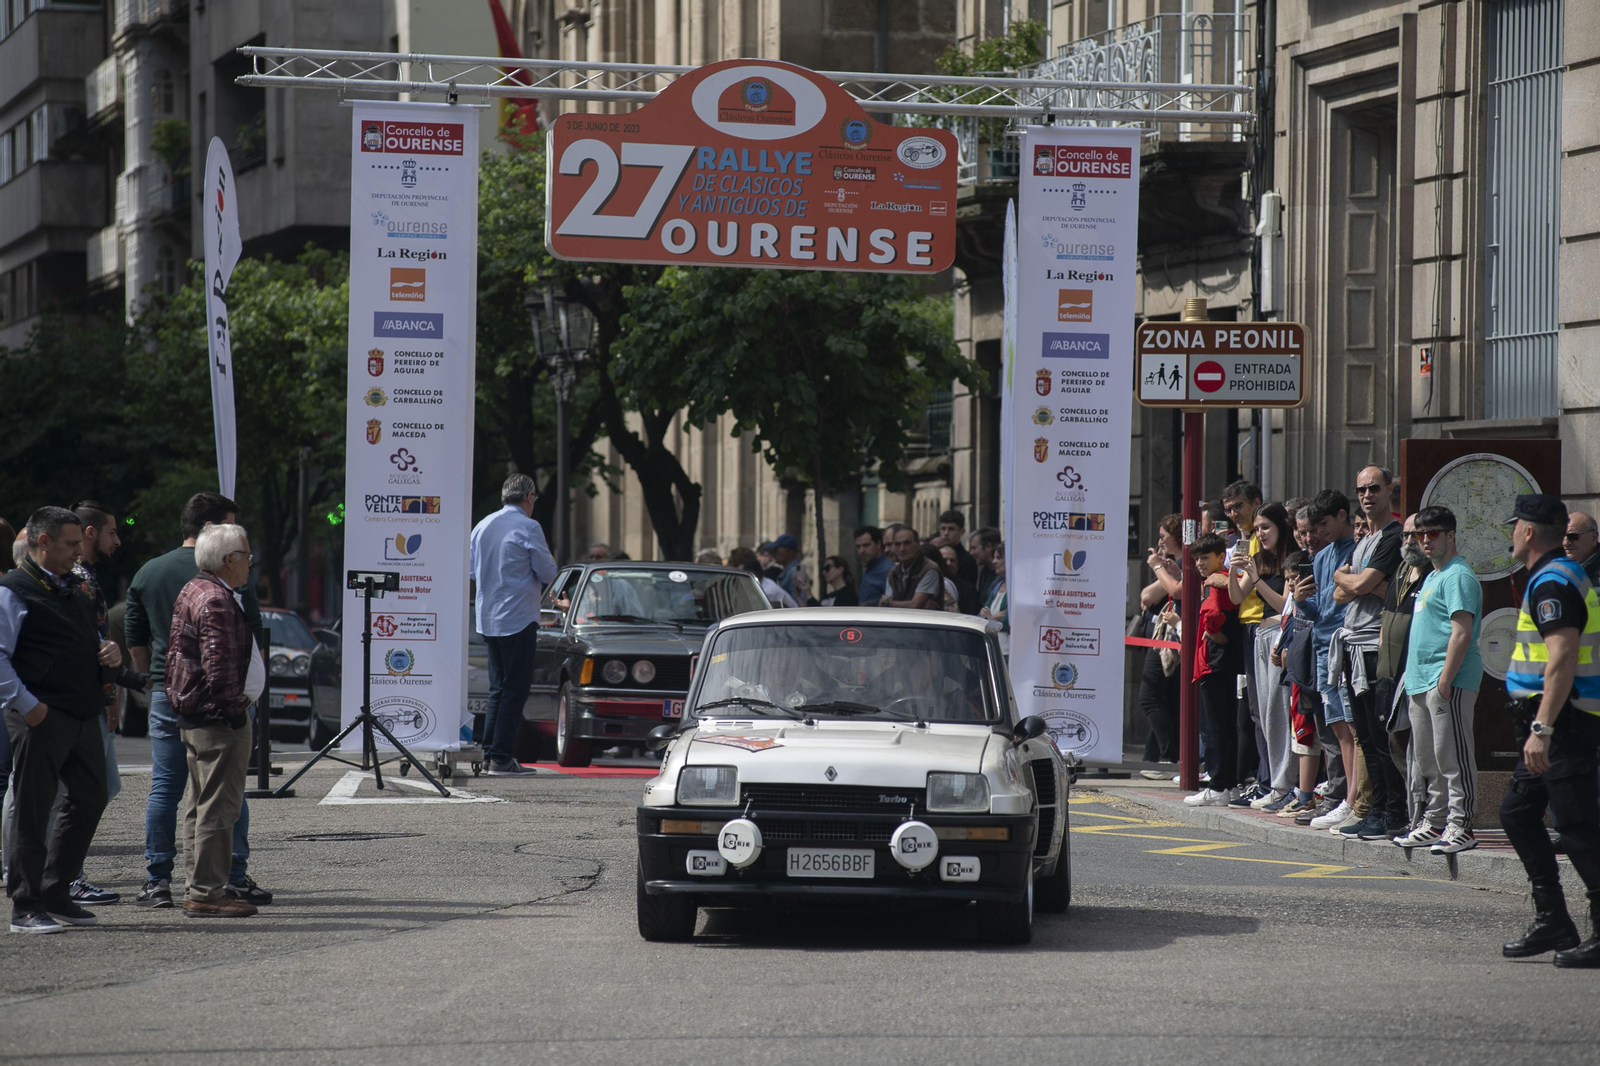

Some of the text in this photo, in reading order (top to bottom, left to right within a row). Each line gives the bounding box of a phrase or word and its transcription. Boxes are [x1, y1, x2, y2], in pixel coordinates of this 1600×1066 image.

[719, 112, 793, 124] Clásicos Ourense
[386, 124, 450, 137] Concello de
[566, 120, 641, 133] 3 DE JUNIO DE 2023
[385, 137, 462, 151] OURENSE
[818, 150, 892, 162] Clásicos Ourense
[1058, 149, 1119, 160] Concello de
[697, 146, 813, 175] RALLYE
[1057, 161, 1130, 175] OURENSE
[843, 173, 876, 181] OURENSE
[555, 138, 695, 240] 27
[692, 173, 803, 196] DE CLASICOS
[371, 192, 410, 200] DEPUTACIÓN
[678, 193, 808, 218] Y ANTIGUOS DE
[870, 201, 922, 213] La Región
[387, 220, 448, 234] ourense
[660, 218, 933, 266] OURENSE
[1056, 243, 1115, 255] ourense
[377, 247, 447, 262] La Región
[1046, 269, 1114, 283] La Región
[391, 291, 424, 299] telemiño
[1060, 312, 1091, 320] telemiño
[1142, 330, 1300, 349] ZONA PEONIL
[394, 350, 433, 358] CONCELLO
[393, 367, 425, 375] AGUIAR
[1061, 370, 1099, 378] CONCELLO
[1234, 363, 1292, 375] ENTRADA
[1229, 380, 1296, 391] PROHIBIDA
[393, 388, 432, 396] CONCELLO
[393, 396, 443, 405] CARBALLIÑO
[392, 422, 445, 431] CONCELLO DE
[365, 494, 402, 504] PONTE
[365, 504, 401, 513] VELLA
[1033, 512, 1069, 521] PONTE
[1033, 520, 1068, 530] VELLA
[1055, 532, 1084, 540] Comercial
[414, 586, 432, 594] Motor
[1066, 590, 1097, 598] ASISTENCIA
[1056, 600, 1078, 609] Celanova
[1079, 602, 1095, 610] Motor
[846, 631, 855, 640] 5
[400, 678, 433, 686] Ourense
[1033, 689, 1096, 700] Clásicos Ourense
[878, 794, 908, 803] Turbo
